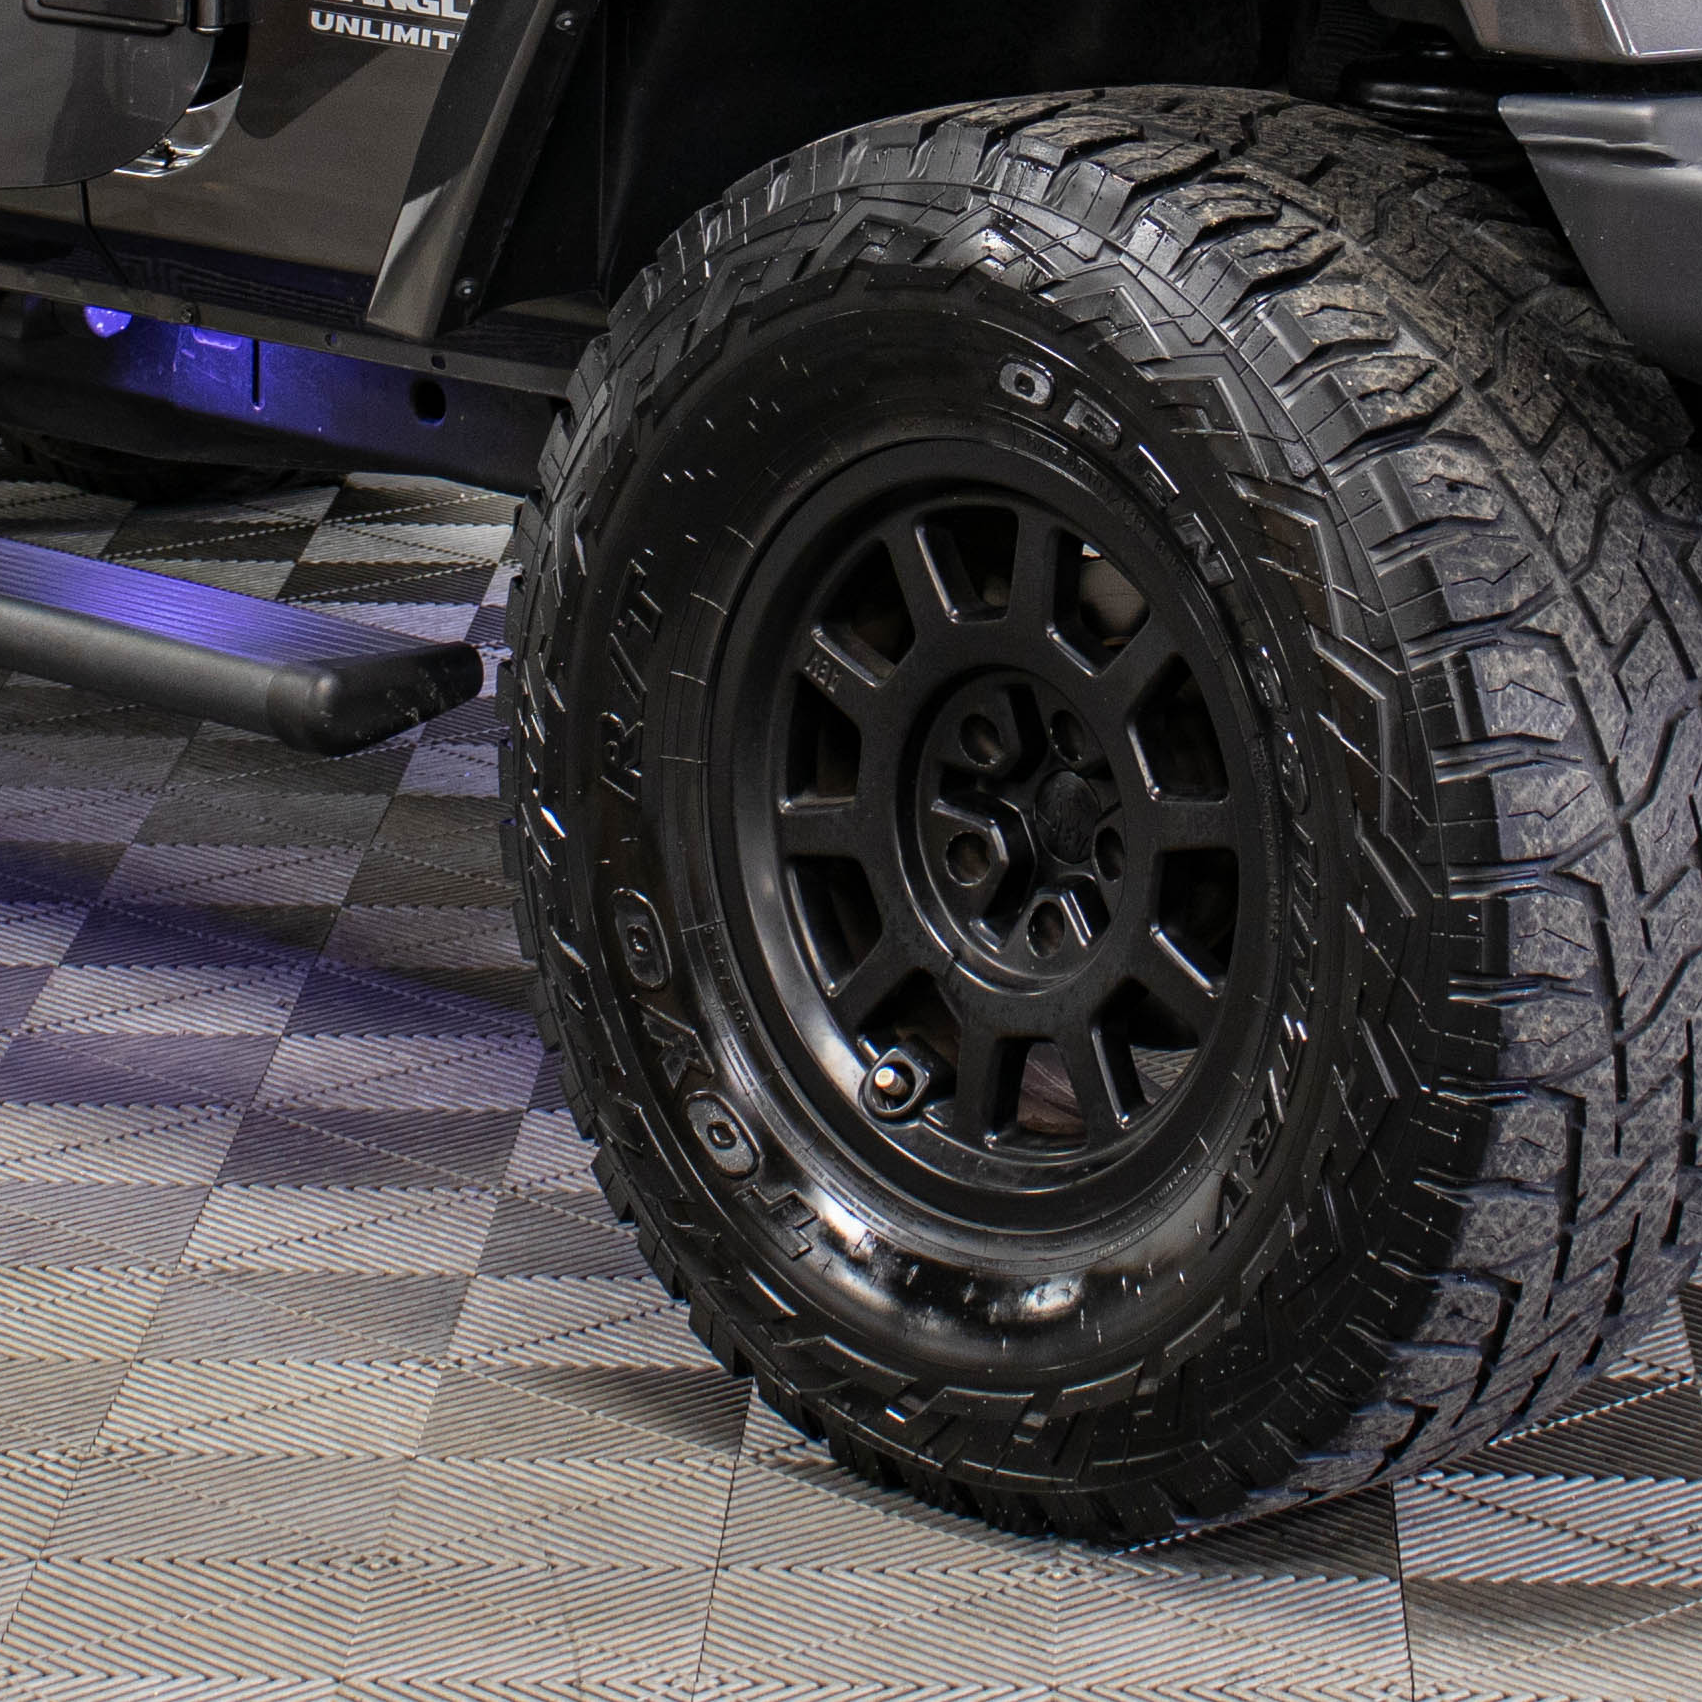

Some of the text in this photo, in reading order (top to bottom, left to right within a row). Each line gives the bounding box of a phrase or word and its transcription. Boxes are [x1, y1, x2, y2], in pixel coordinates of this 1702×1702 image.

[311, 10, 461, 51] UNLIMIT
[999, 352, 1235, 587] OPEN
[599, 558, 665, 801] R/T
[611, 888, 819, 1261] TOYO
